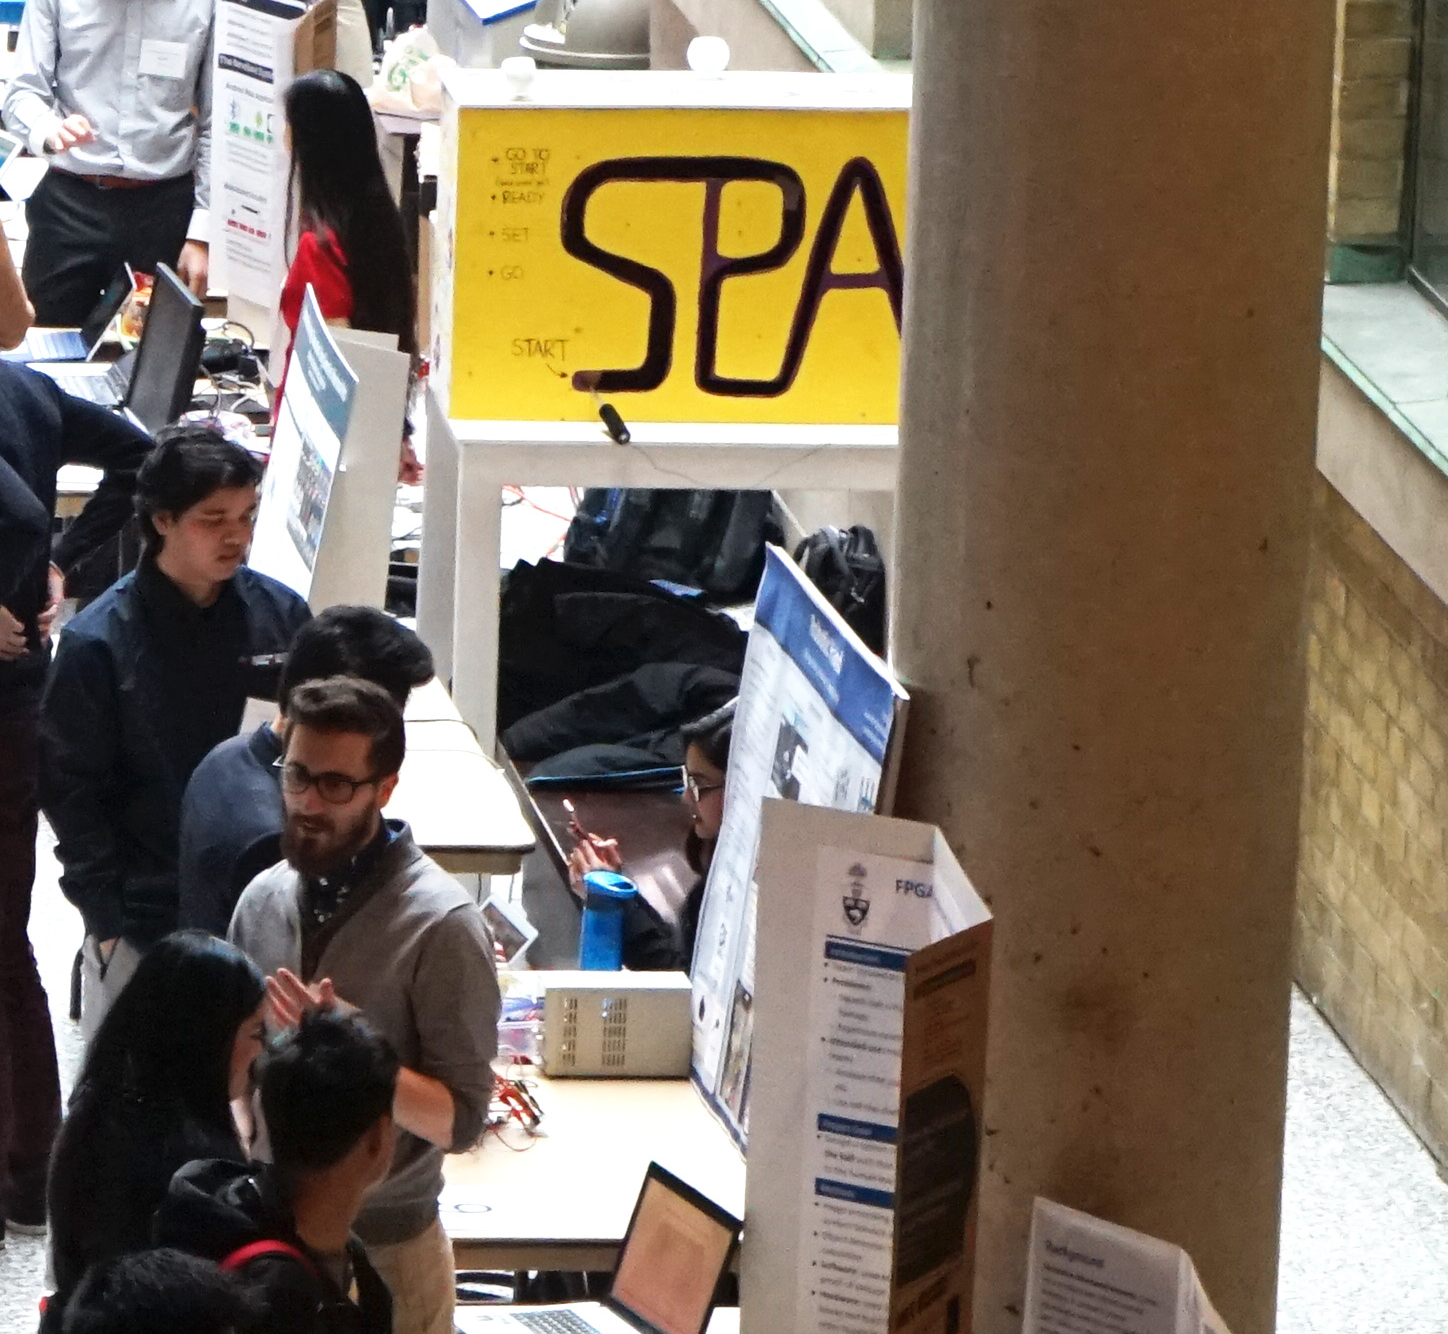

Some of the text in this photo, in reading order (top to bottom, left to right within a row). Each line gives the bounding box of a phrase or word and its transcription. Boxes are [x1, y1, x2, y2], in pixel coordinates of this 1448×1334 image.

[506, 147, 551, 162] GO TO
[510, 162, 547, 175] START
[501, 190, 546, 205] READY
[501, 227, 529, 242] SET
[500, 265, 525, 281] GO
[511, 338, 570, 362] START
